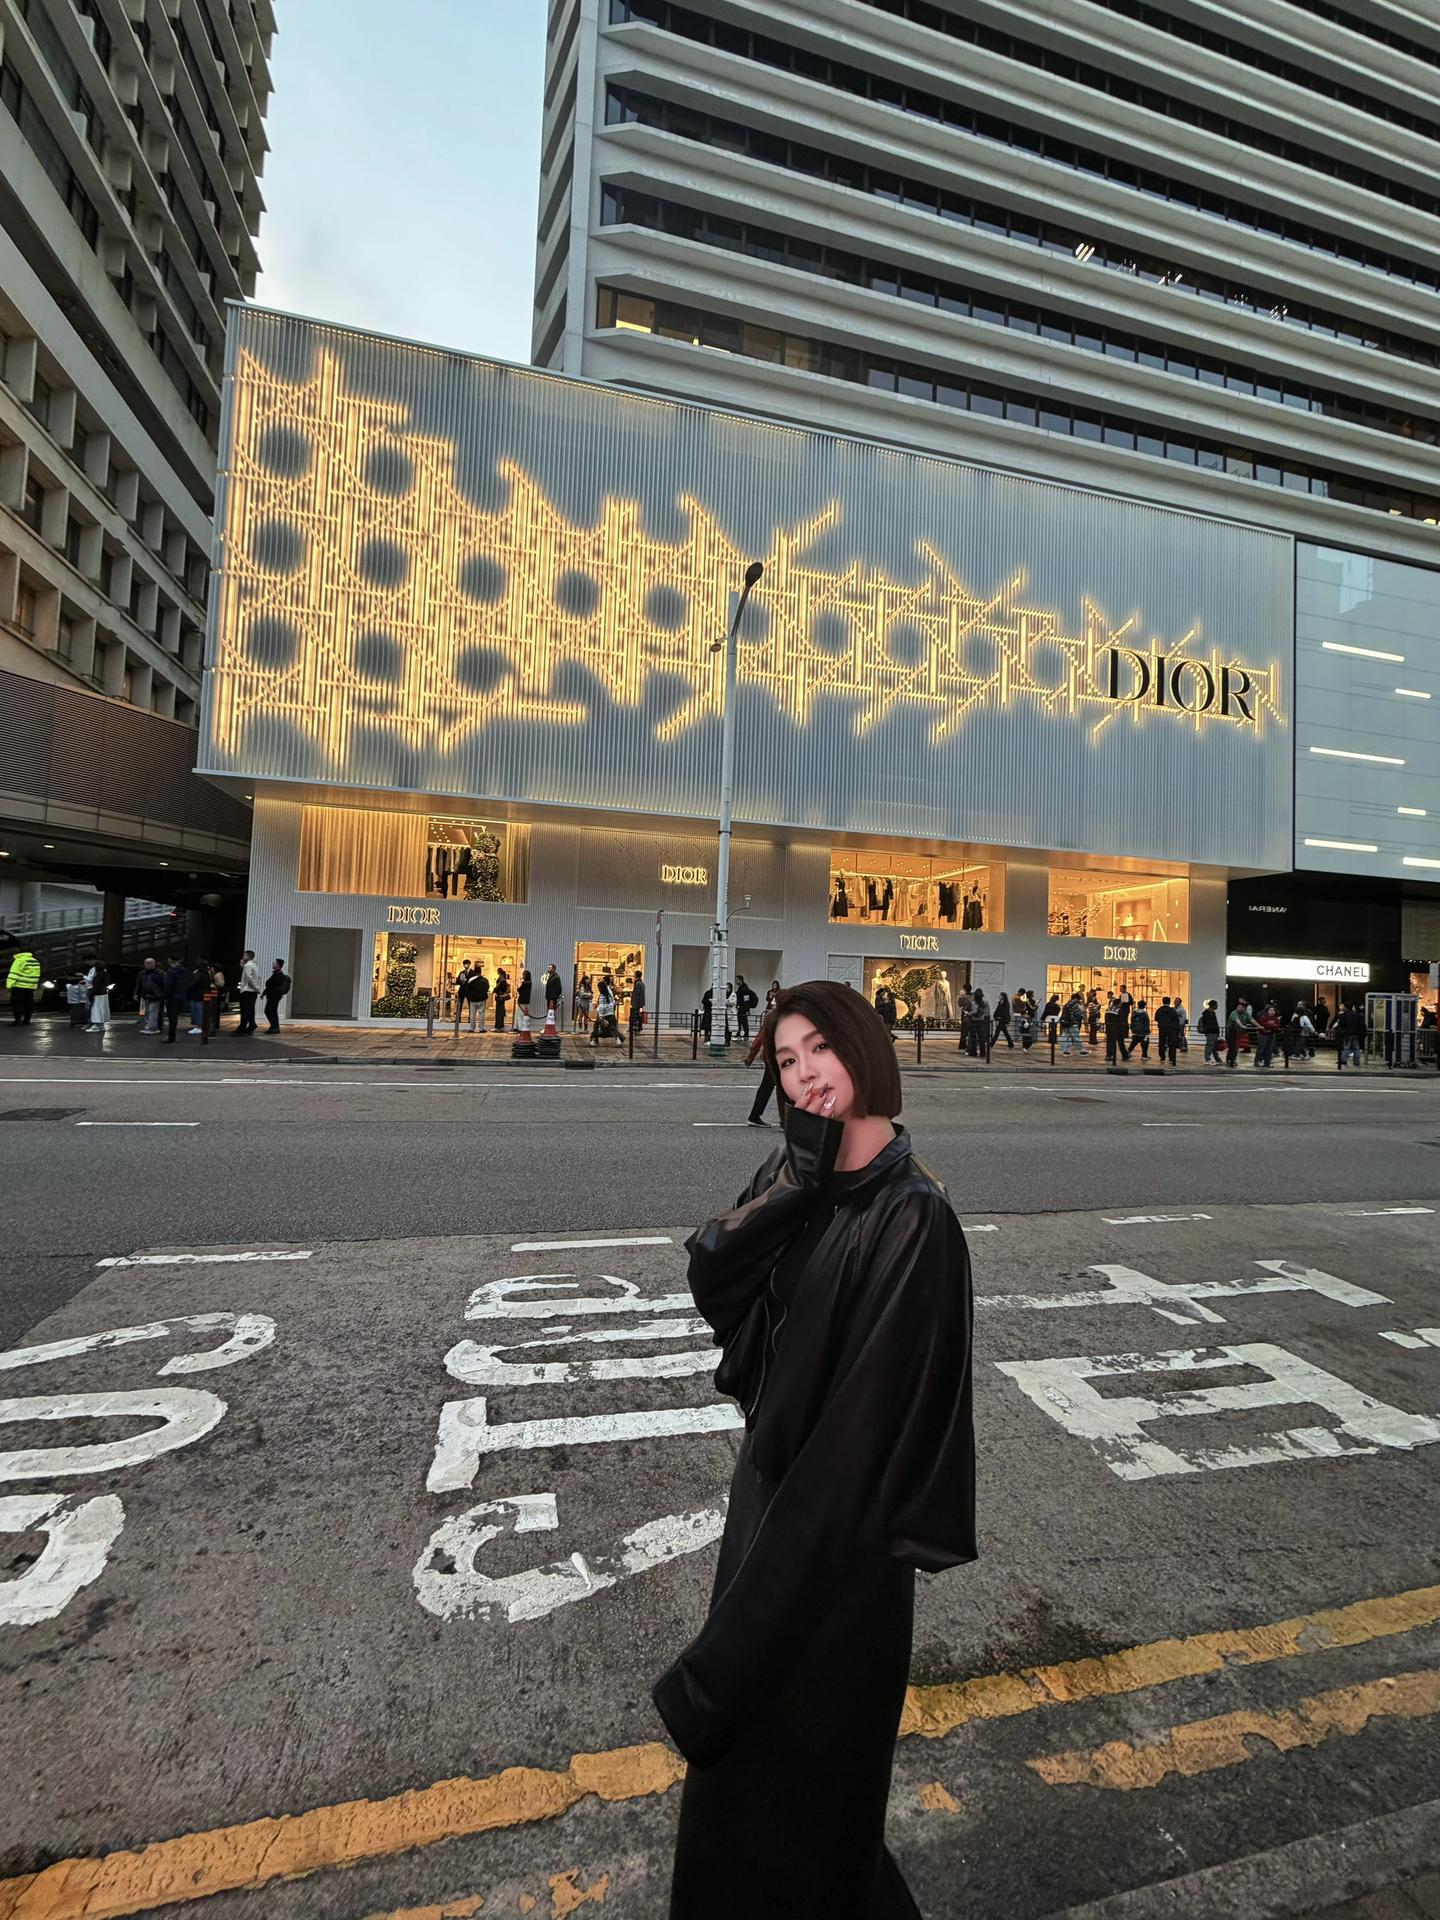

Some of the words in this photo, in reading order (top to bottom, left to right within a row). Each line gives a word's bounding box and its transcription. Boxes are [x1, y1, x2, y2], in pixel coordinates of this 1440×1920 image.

[1107, 646, 1256, 721] DIOR
[661, 865, 708, 885] DIOR
[387, 905, 441, 925] DIOR
[899, 934, 940, 952] DIOR
[1103, 945, 1138, 961] DIOR
[1316, 964, 1368, 978] CHANEL
